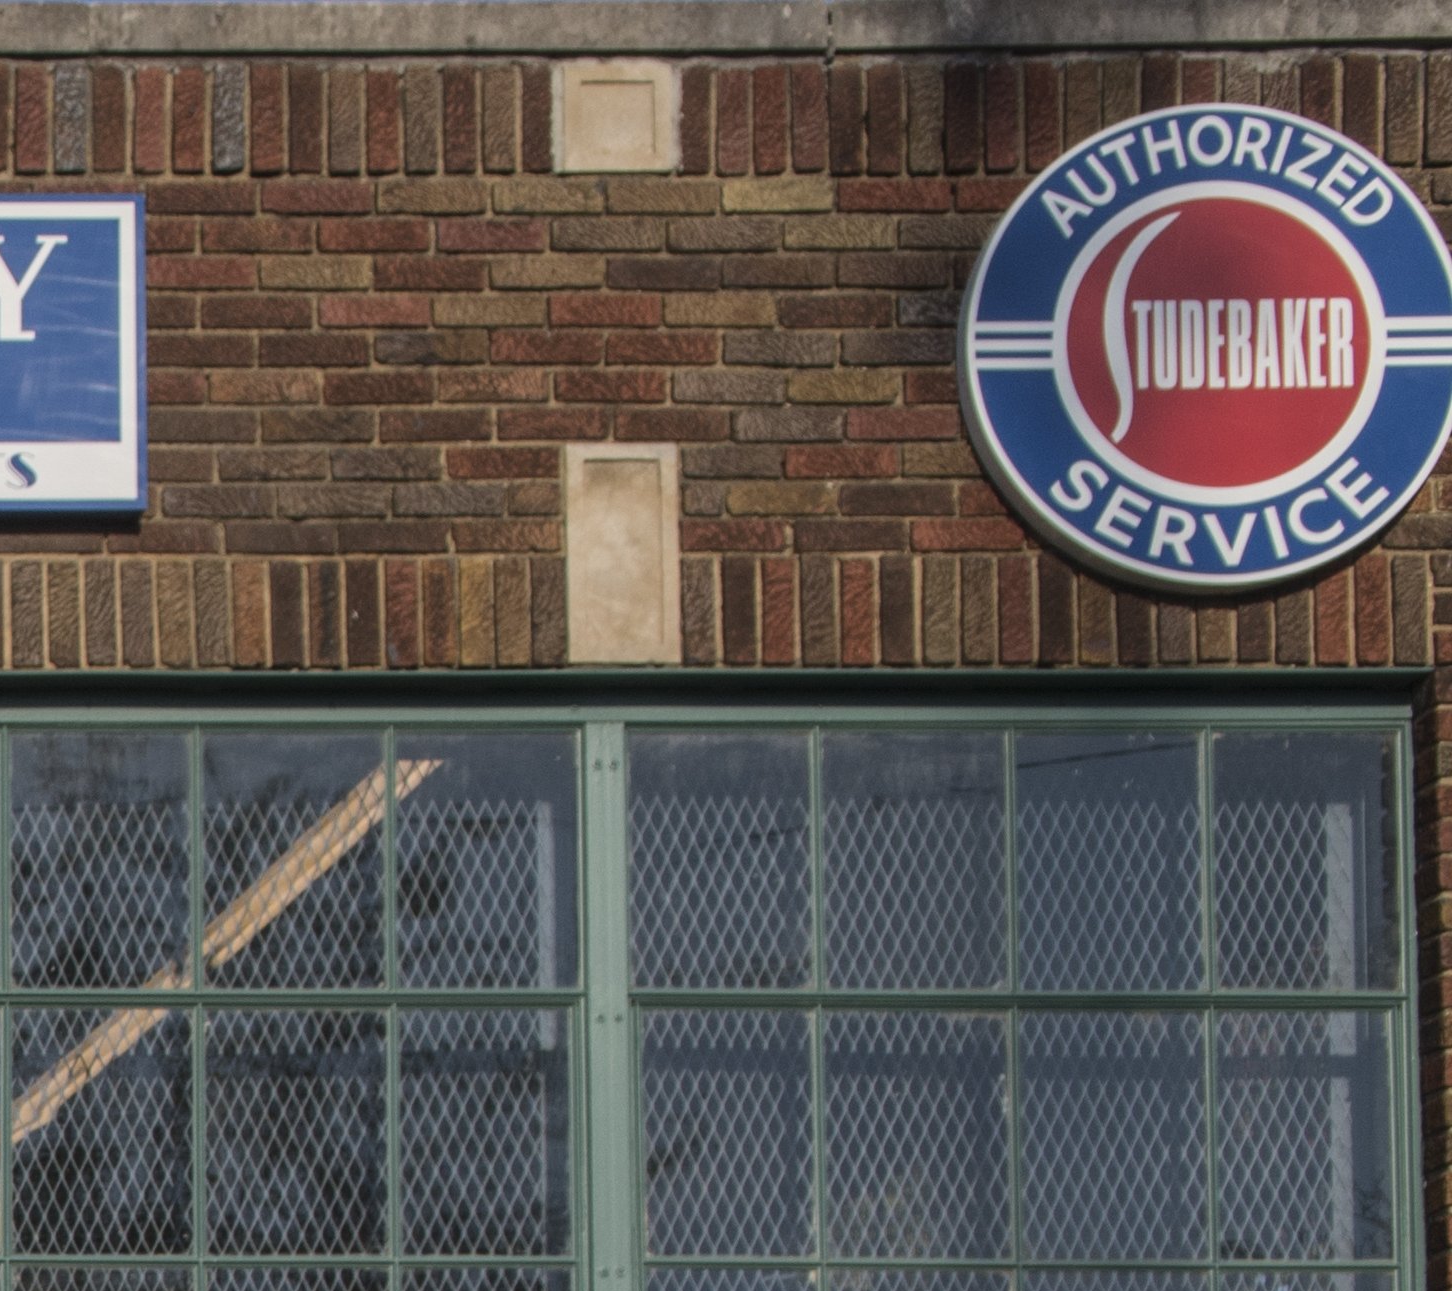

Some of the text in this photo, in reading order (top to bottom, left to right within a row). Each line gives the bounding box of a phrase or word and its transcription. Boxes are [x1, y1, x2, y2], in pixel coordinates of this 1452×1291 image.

[1040, 114, 1395, 240] AUTHORIZED
[1103, 210, 1356, 444] STUDEBAKER
[1050, 457, 1390, 568] SERVICE
